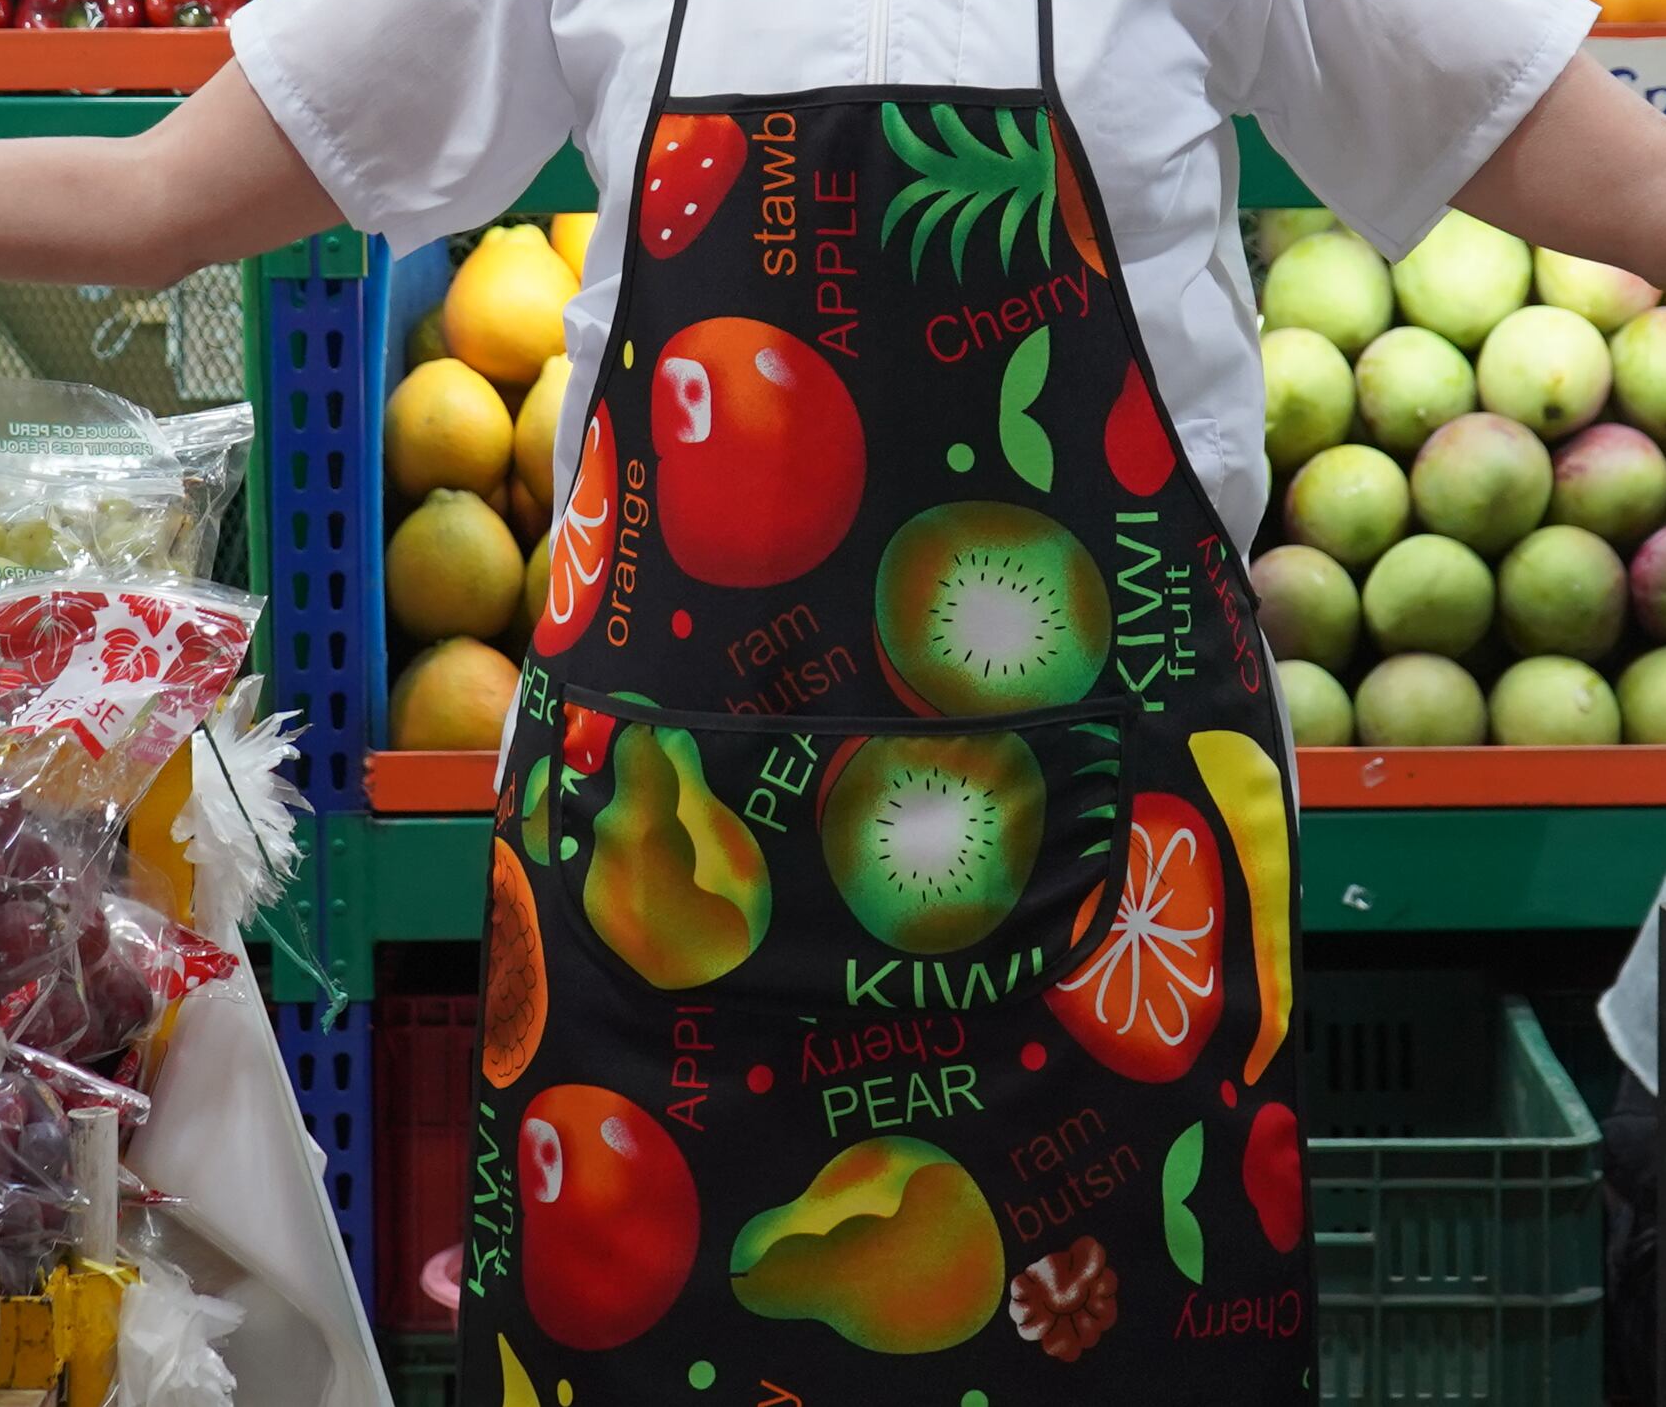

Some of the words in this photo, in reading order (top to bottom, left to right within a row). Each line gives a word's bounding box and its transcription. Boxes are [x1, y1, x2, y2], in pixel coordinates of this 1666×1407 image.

[753, 110, 797, 277] stawb
[815, 170, 859, 358] APPLE
[924, 266, 1093, 364] Cherry
[607, 459, 650, 648] orange
[728, 599, 820, 676] ram
[1116, 511, 1166, 712] KIWI
[1165, 564, 1196, 681] fruit
[1196, 533, 1261, 694] Cherry
[802, 1016, 966, 1084] Cherry
[822, 1064, 985, 1138] PEAR
[468, 1102, 500, 1298] KIWI
[1003, 1144, 1142, 1243] butsn
[1009, 1107, 1107, 1182] ram
[494, 1165, 514, 1277] fruit
[1174, 1288, 1302, 1340] Cherry
